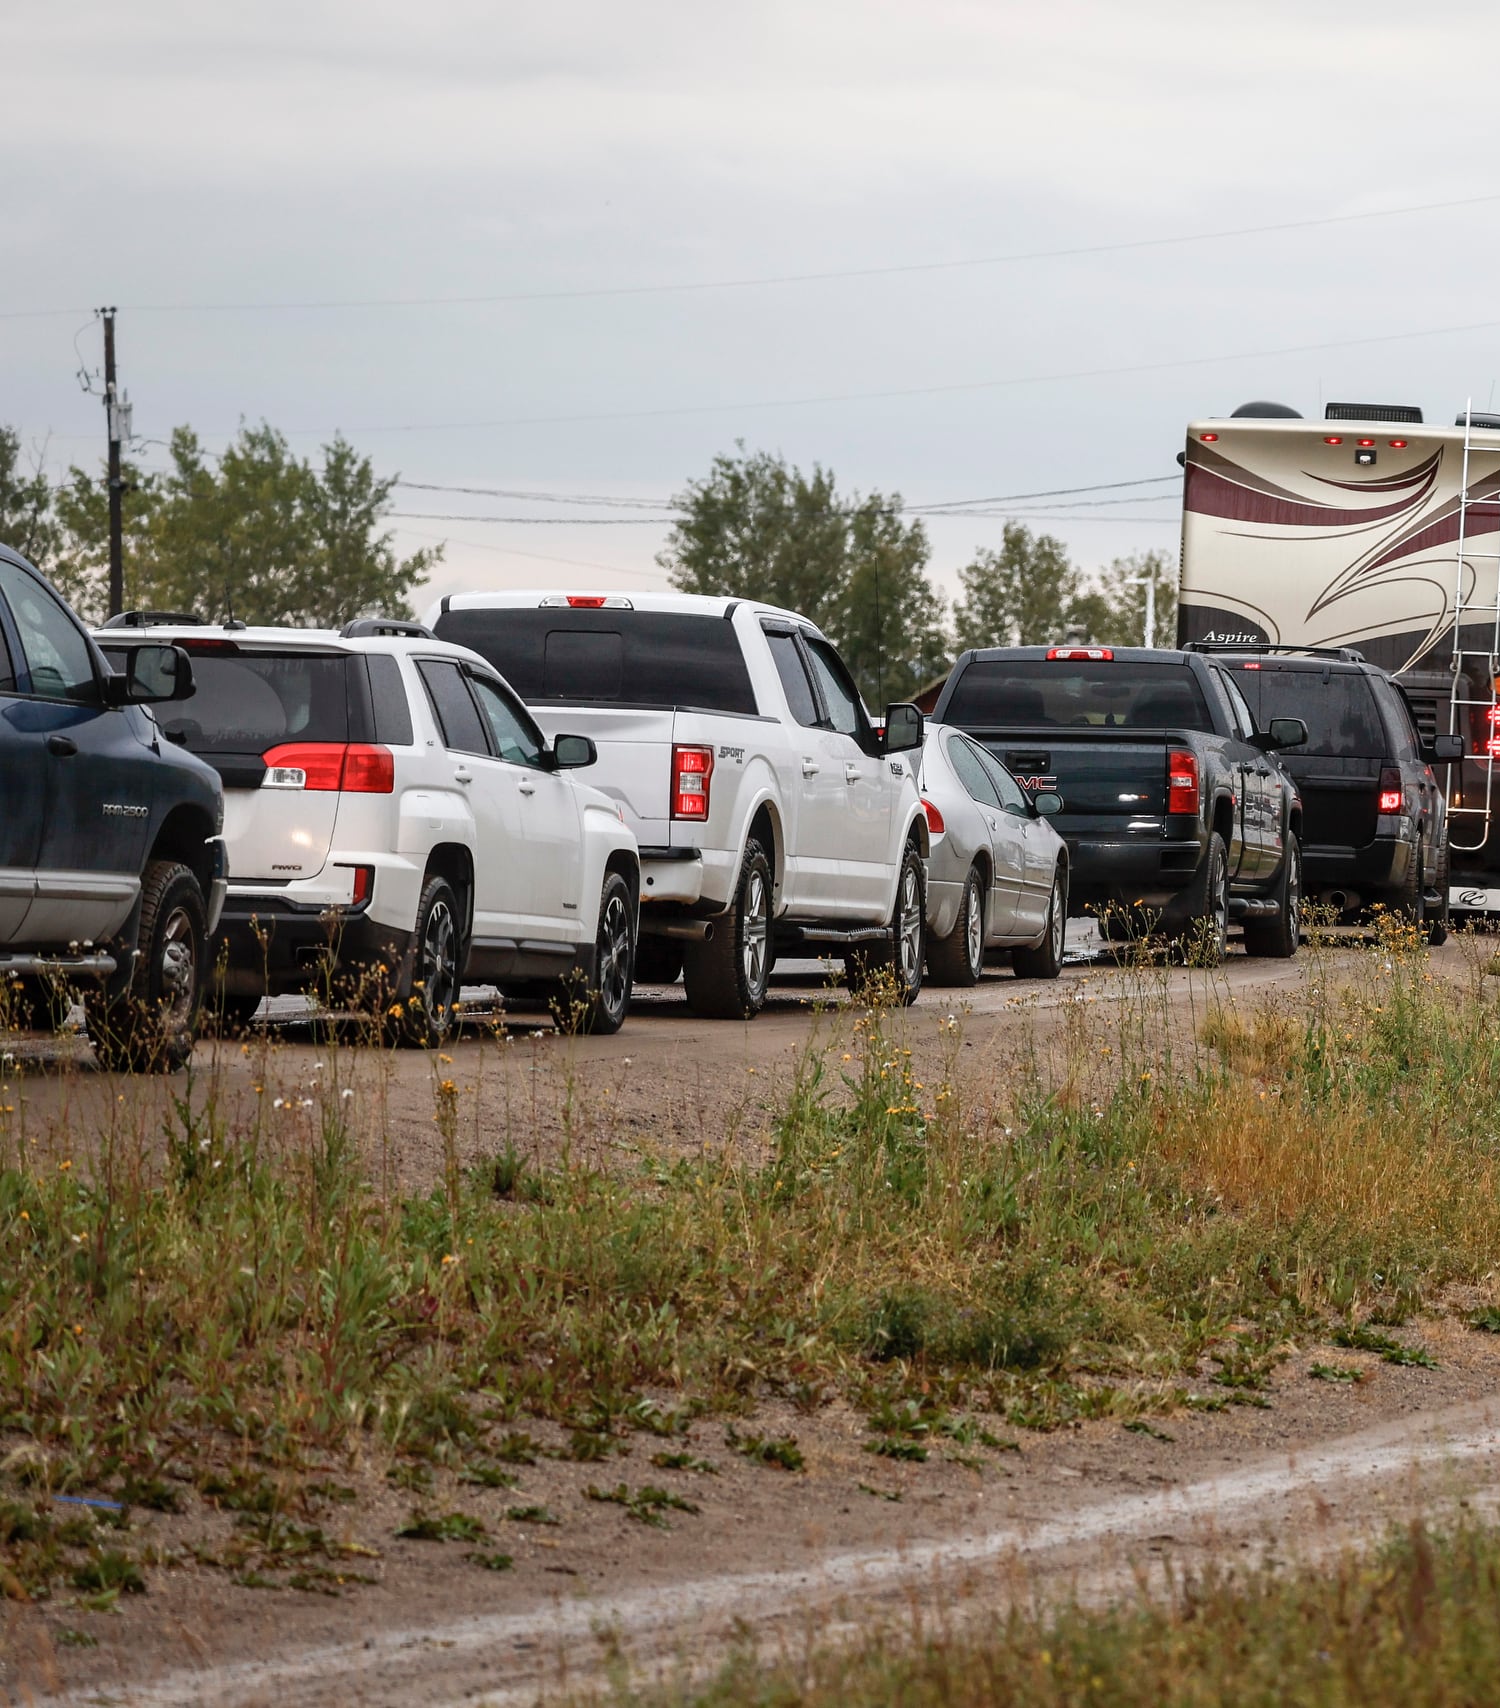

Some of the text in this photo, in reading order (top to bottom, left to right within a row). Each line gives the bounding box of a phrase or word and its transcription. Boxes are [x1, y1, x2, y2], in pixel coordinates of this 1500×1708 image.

[1202, 630, 1258, 644] Aspire
[718, 745, 745, 758] SPORT
[1013, 775, 1057, 790] MC
[102, 803, 149, 817] RAM 2500
